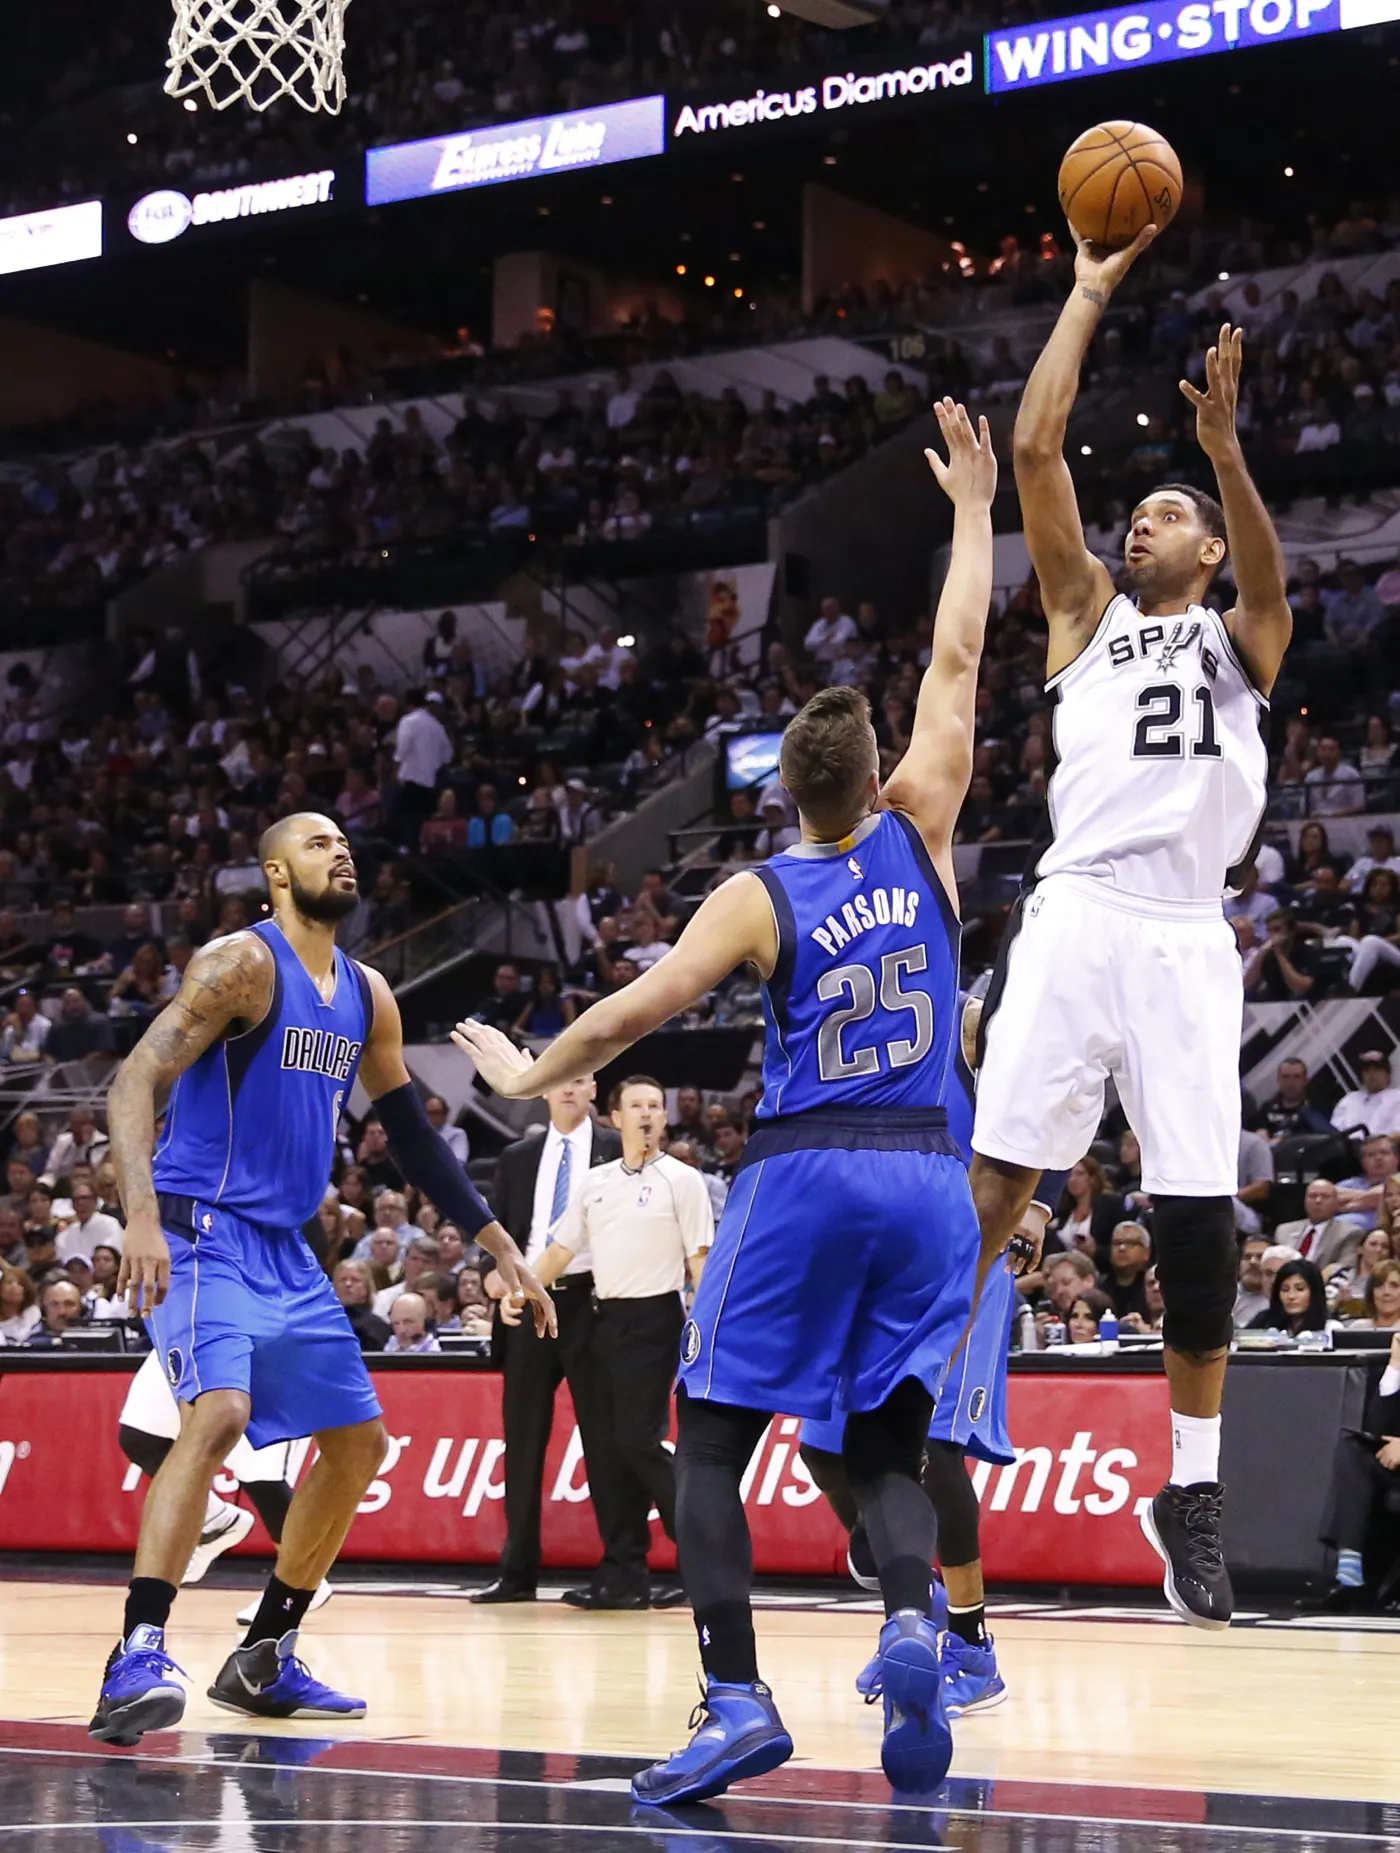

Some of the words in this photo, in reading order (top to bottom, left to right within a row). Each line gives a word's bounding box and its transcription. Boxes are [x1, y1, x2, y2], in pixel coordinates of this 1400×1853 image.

[673, 89, 817, 137] Americus
[822, 50, 973, 110] Diamond
[1130, 681, 1224, 761] 21
[811, 887, 919, 956] PARSONS
[817, 943, 933, 1081] 25
[281, 1026, 361, 1081] DALLAS
[423, 1437, 506, 1518] up
